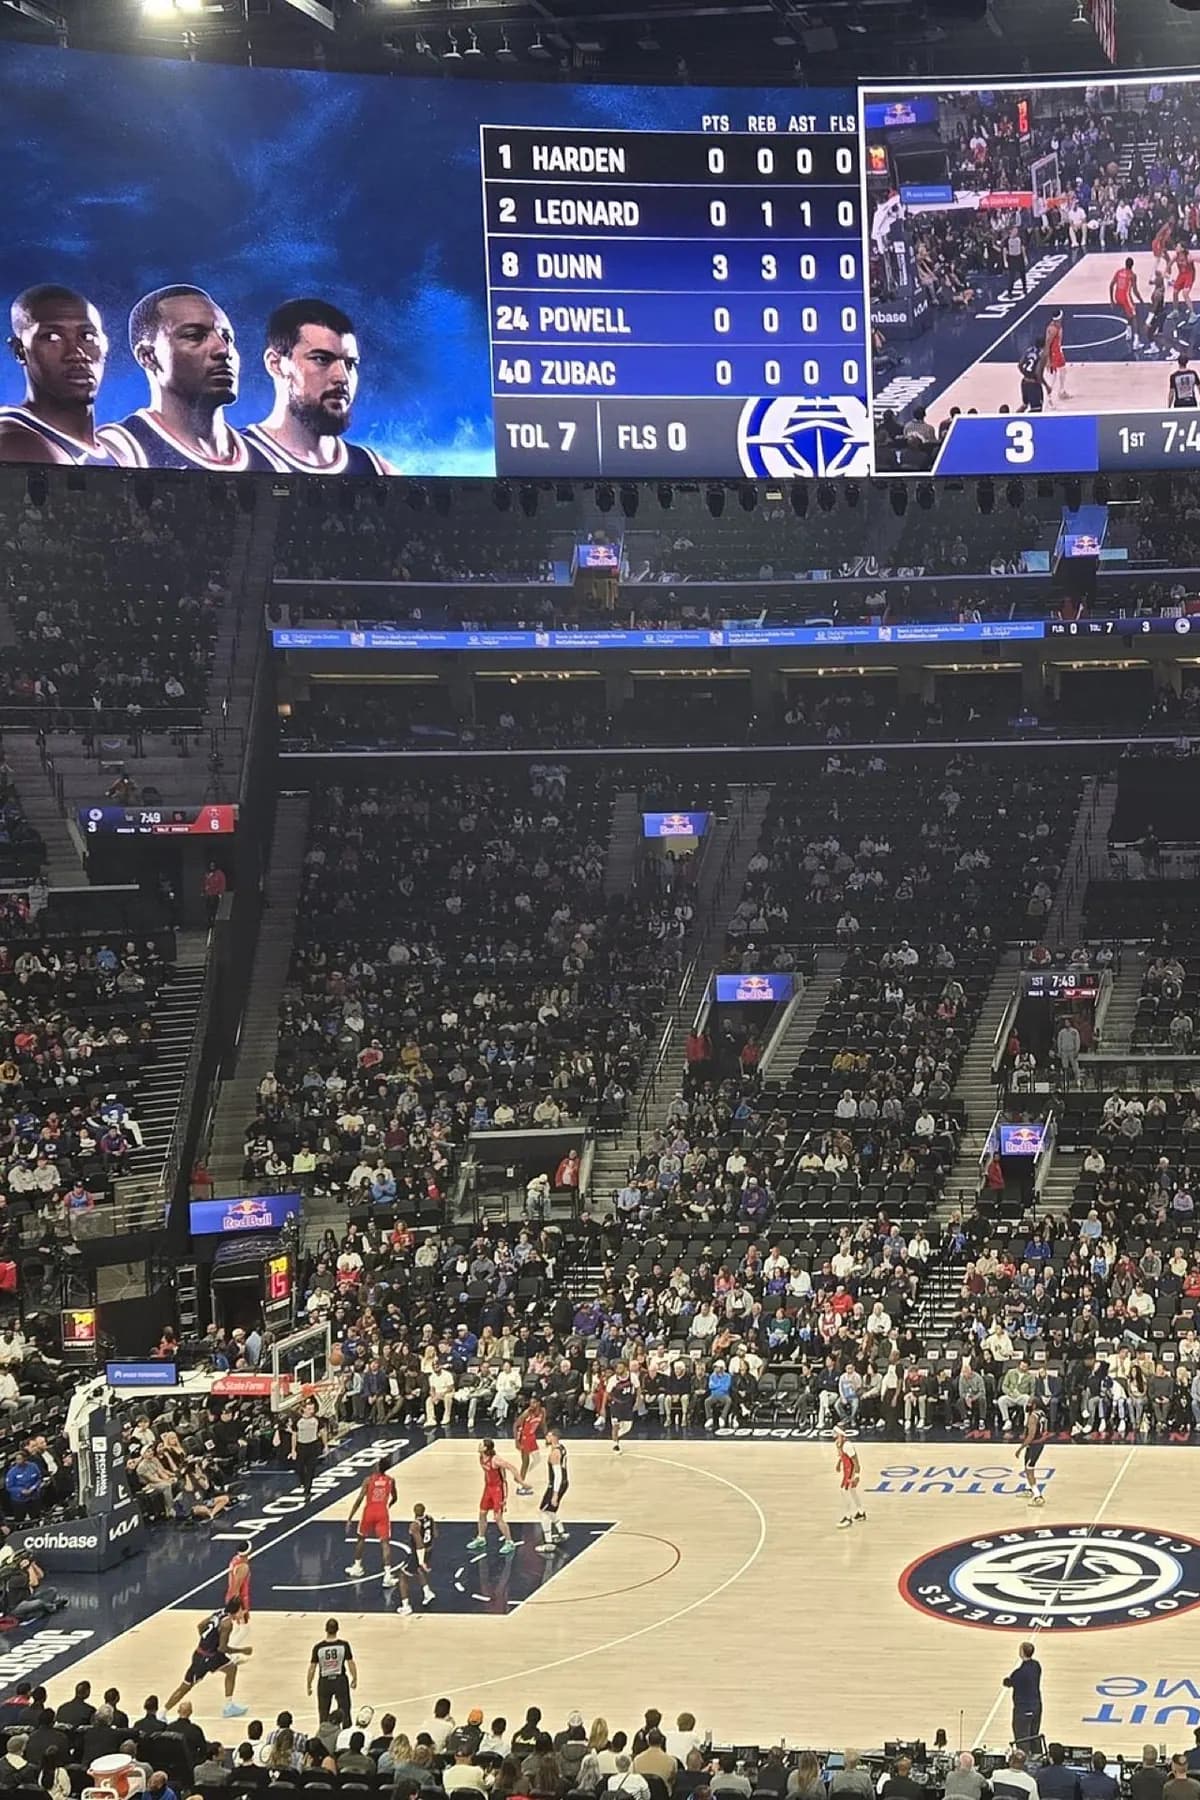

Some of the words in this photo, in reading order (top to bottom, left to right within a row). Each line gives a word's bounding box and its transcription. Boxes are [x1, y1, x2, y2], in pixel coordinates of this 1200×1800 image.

[702, 116, 730, 132] PTS
[748, 116, 776, 132] REB
[789, 116, 816, 132] AST
[830, 116, 855, 132] FLS
[499, 145, 512, 168] 1
[533, 146, 625, 173] HARDEN
[708, 148, 724, 174] 0
[758, 148, 773, 174] 0
[797, 148, 812, 174] 0
[836, 148, 852, 174] 0
[500, 198, 516, 223] 2
[535, 199, 639, 226] LEONARD
[711, 201, 726, 226] 0
[762, 202, 772, 226] 1
[801, 202, 811, 226] 1
[838, 201, 853, 226] 0
[502, 253, 518, 277] 8
[537, 255, 602, 279] DUNN
[713, 255, 728, 280] 3
[762, 255, 777, 280] 3
[801, 255, 816, 280] 0
[840, 255, 855, 280] 0
[497, 307, 528, 331] 24
[540, 308, 631, 333] POWELL
[714, 308, 730, 333] 0
[763, 308, 778, 333] 0
[802, 308, 817, 333] 0
[841, 308, 856, 333] 0
[498, 360, 531, 384] 40
[541, 360, 616, 385] ZUBAC
[717, 360, 732, 385] 0
[765, 360, 780, 385] 0
[804, 360, 819, 385] 0
[843, 360, 858, 385] 0
[506, 424, 549, 449] TOL
[559, 422, 576, 451] 7
[618, 425, 656, 450] FLS
[668, 422, 686, 451] 0
[1005, 422, 1034, 463] 3
[1119, 428, 1145, 454] 1ST
[1143, 622, 1150, 632] 3
[88, 822, 96, 832] 3
[211, 820, 219, 830] 6
[223, 1214, 249, 1230] Red
[249, 1212, 272, 1227] Bull
[23, 1534, 98, 1549] coinbase
[211, 1516, 283, 1541] LA
[424, 1529, 431, 1542] 8
[970, 1527, 1193, 1554] CLIPPERS
[918, 1584, 1092, 1629] ANGELES
[1127, 1589, 1200, 1620] LOS
